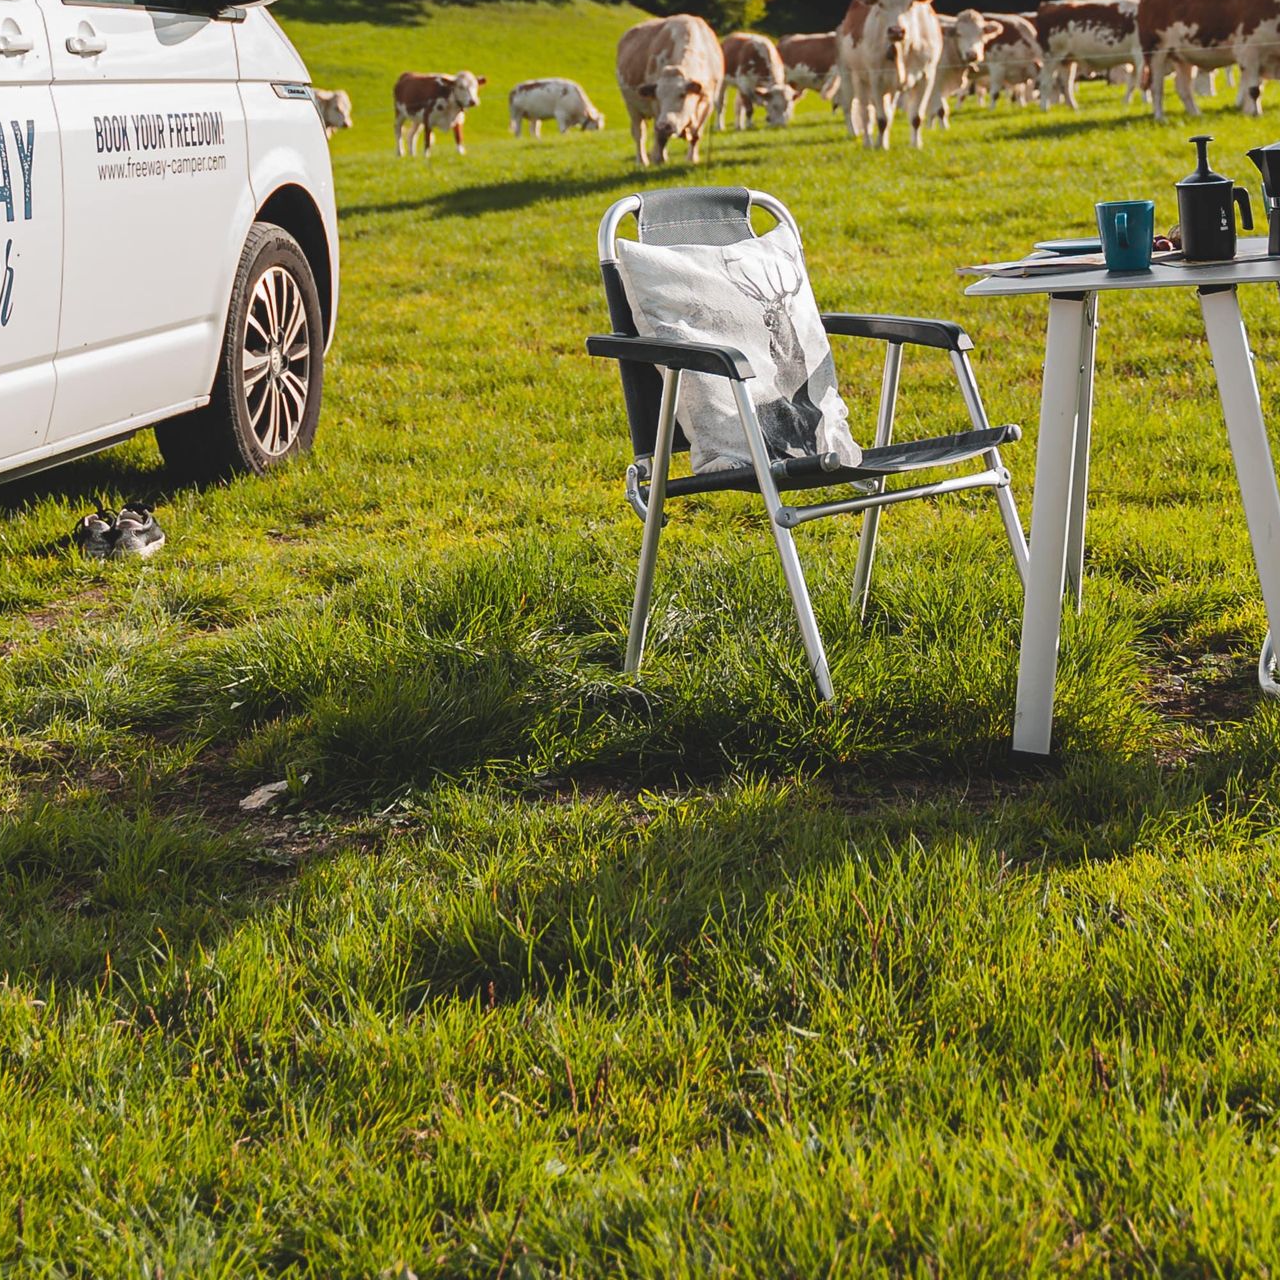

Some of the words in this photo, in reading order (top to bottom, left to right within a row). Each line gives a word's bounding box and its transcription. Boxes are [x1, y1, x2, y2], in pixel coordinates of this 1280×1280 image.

[94, 115, 131, 153] BOOK
[131, 113, 166, 150] YOUR
[167, 111, 225, 148] FREEDOM!
[98, 155, 227, 181] www.freeway-camper.com
